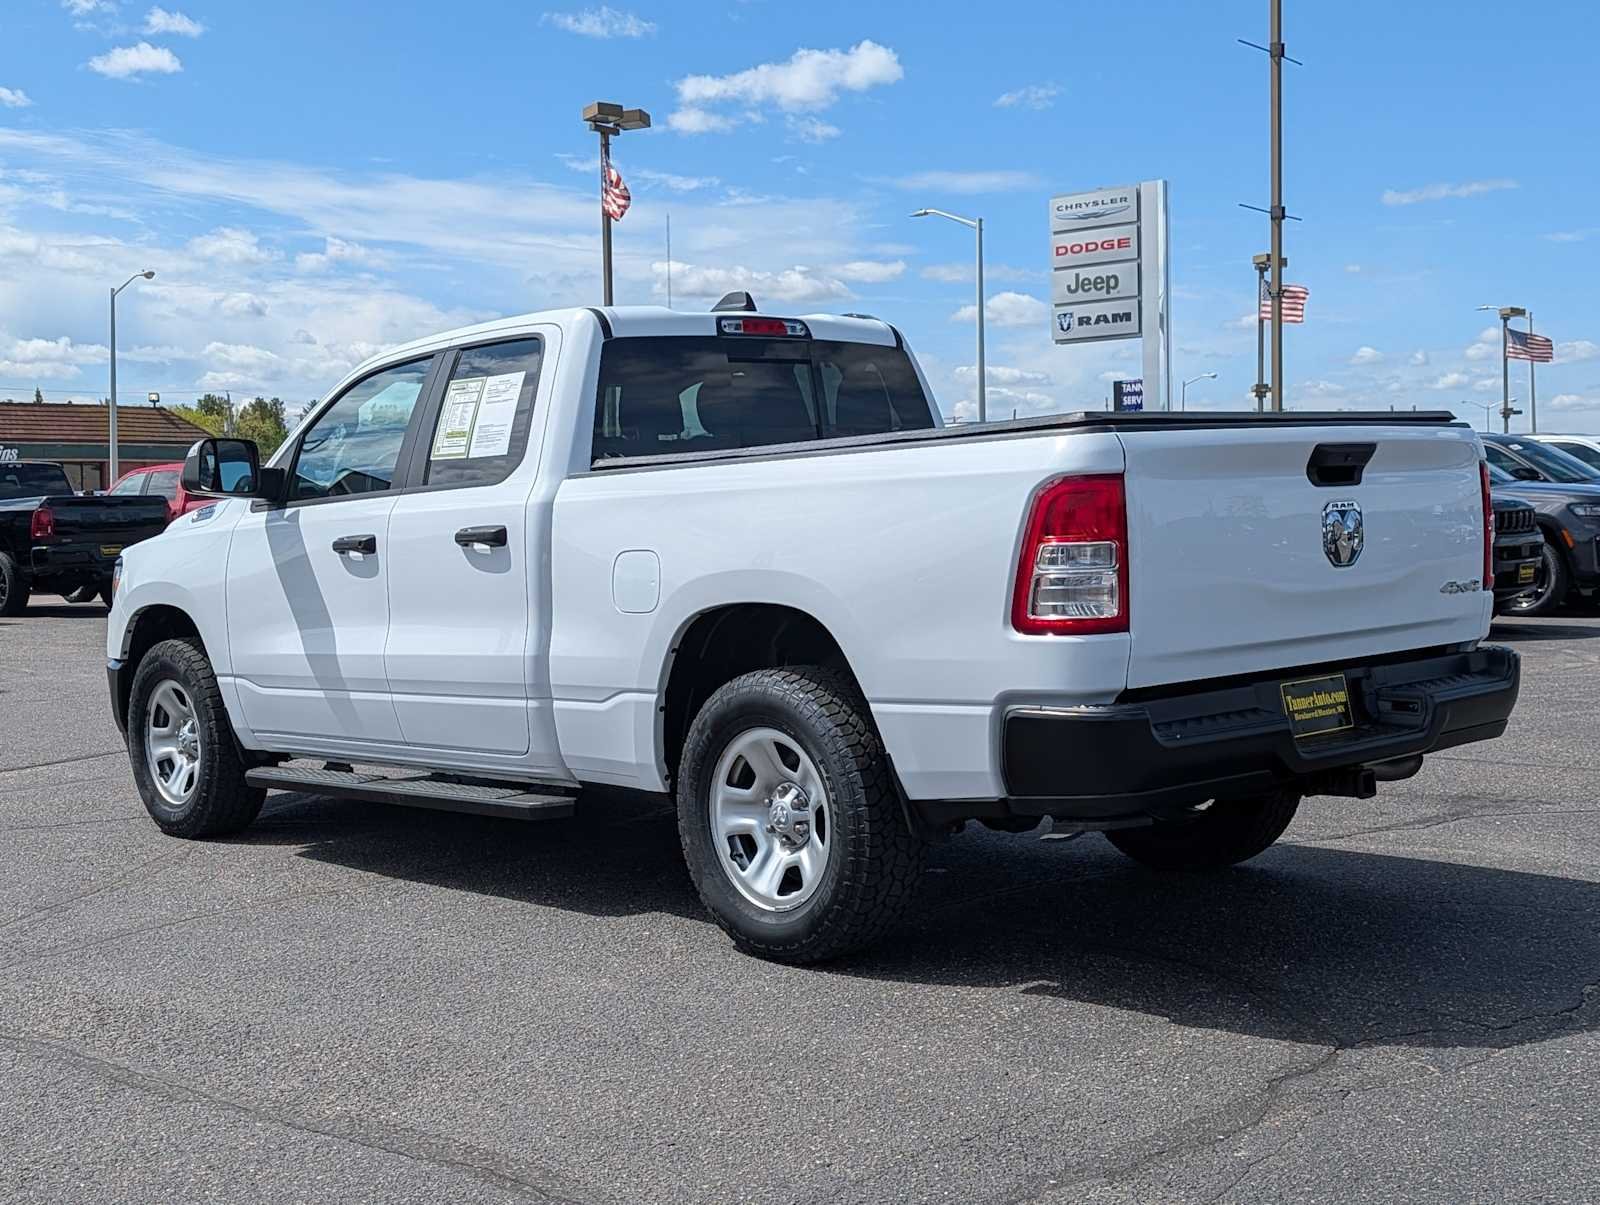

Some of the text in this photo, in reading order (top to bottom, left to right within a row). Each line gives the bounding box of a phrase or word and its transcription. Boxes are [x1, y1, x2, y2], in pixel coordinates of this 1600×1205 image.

[1056, 196, 1128, 212] CHRYSLER
[1055, 237, 1131, 257] DODGE
[1066, 272, 1119, 295] Jeep
[1077, 311, 1132, 327] RAM
